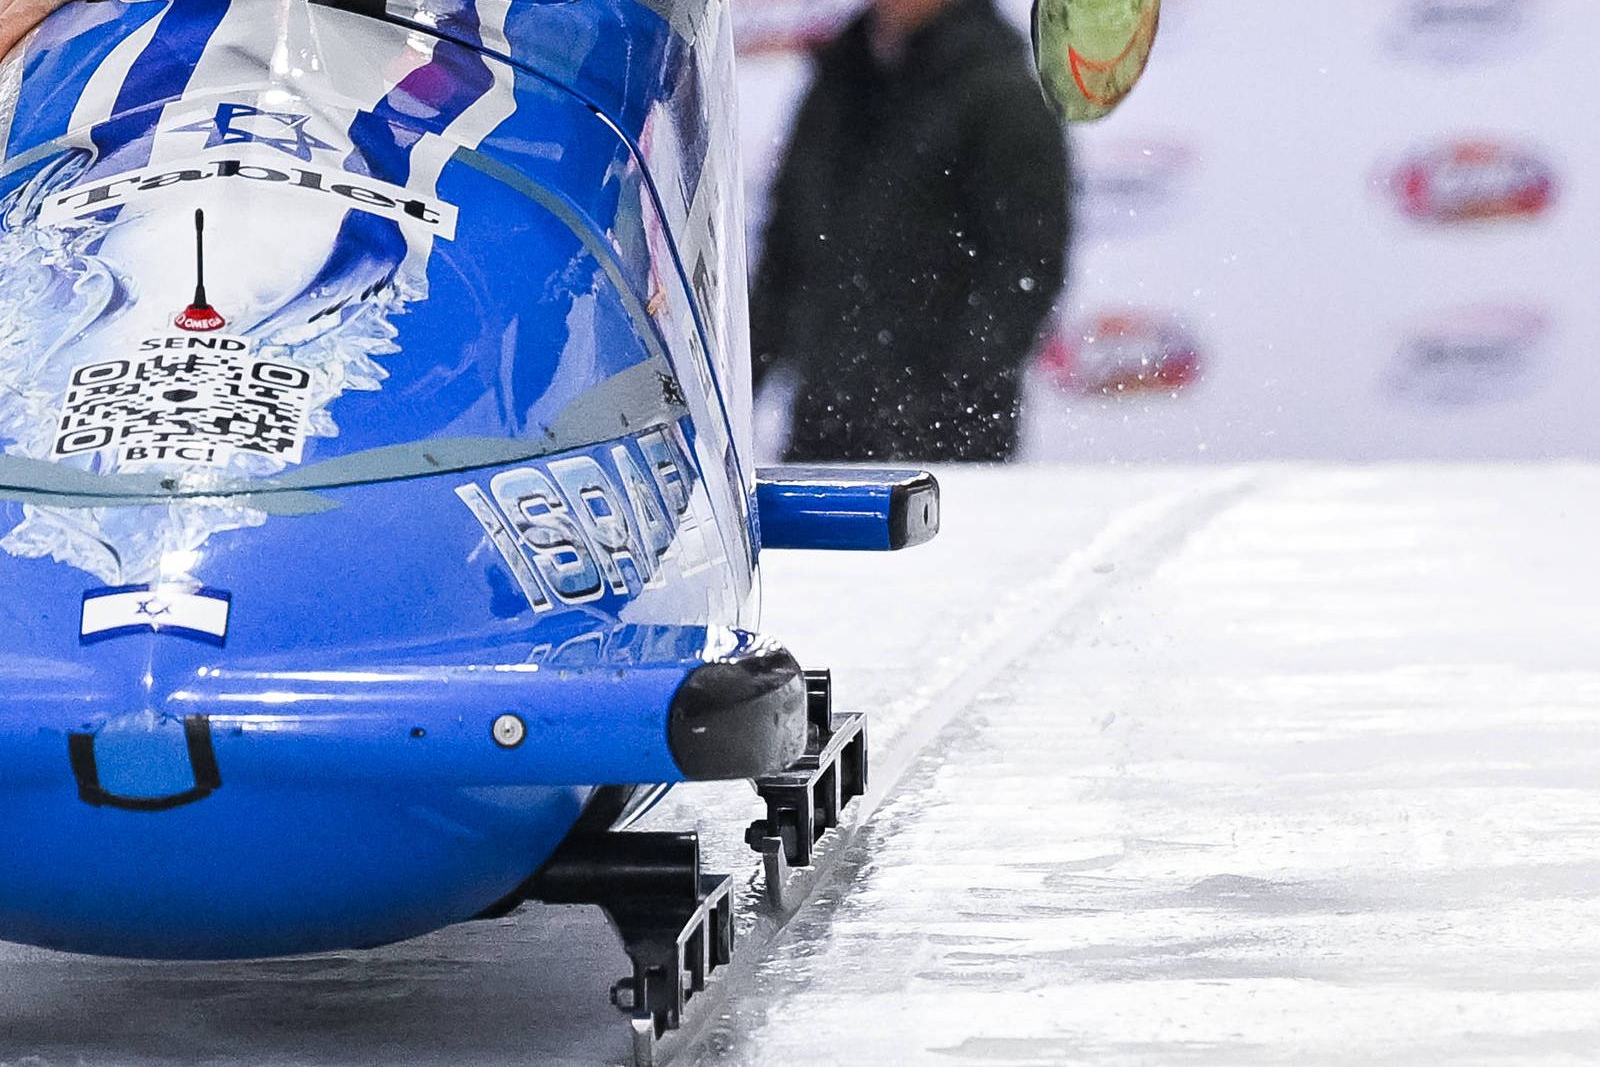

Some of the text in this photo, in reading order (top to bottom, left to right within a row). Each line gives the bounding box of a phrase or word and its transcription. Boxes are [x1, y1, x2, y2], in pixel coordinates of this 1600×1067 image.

[56, 159, 440, 226] Tablet
[138, 337, 247, 352] SEND
[125, 446, 216, 462] BTC!
